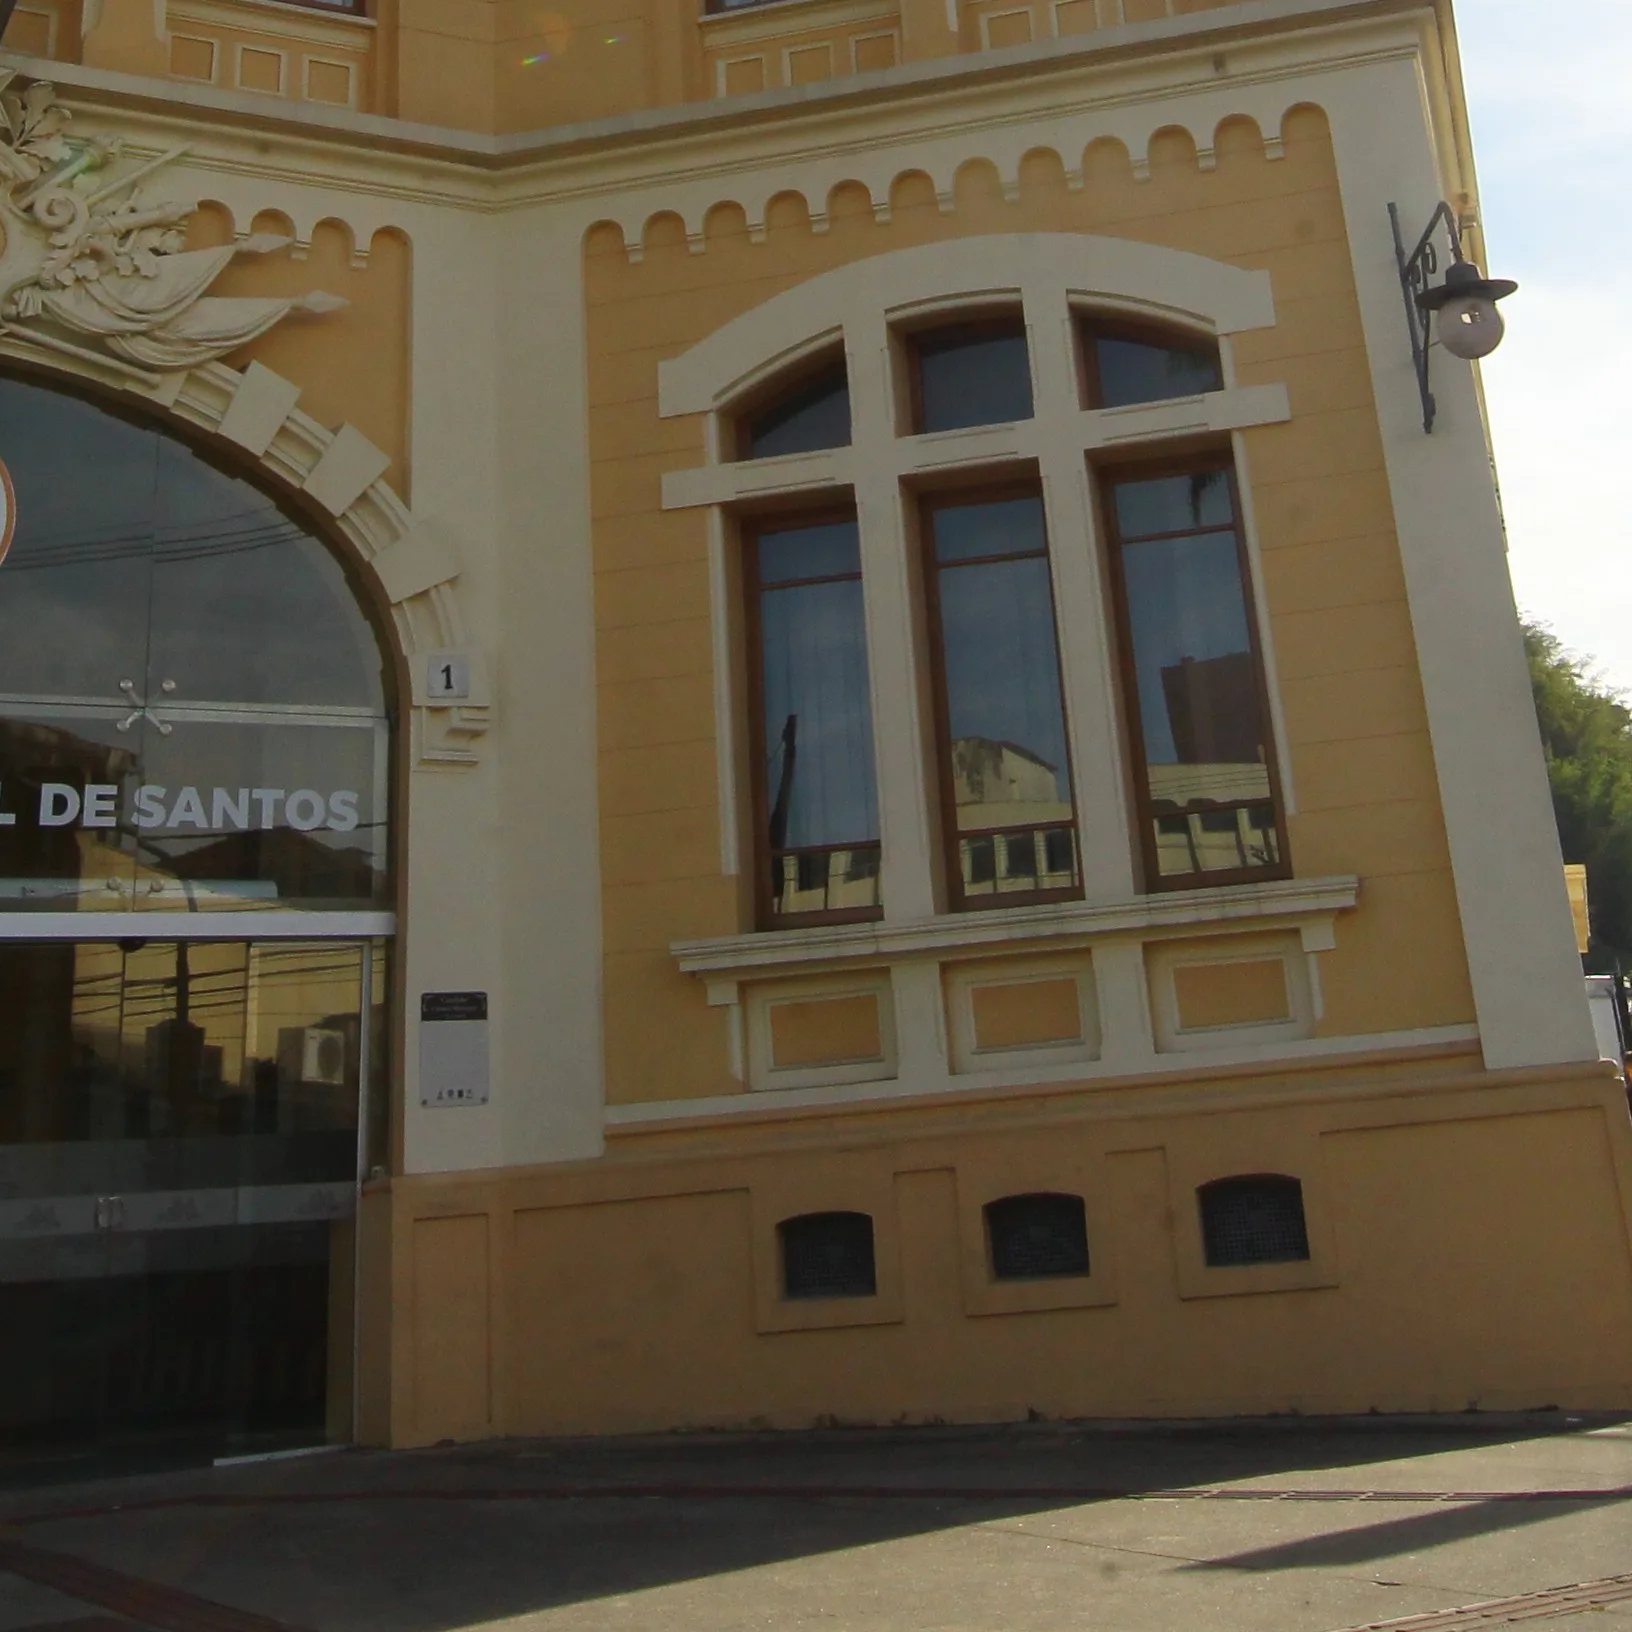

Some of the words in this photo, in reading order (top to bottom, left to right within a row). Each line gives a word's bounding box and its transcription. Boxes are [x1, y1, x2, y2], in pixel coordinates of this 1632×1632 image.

[441, 664, 454, 689] 1
[39, 782, 118, 828] DE
[131, 785, 360, 832] SANTOS
